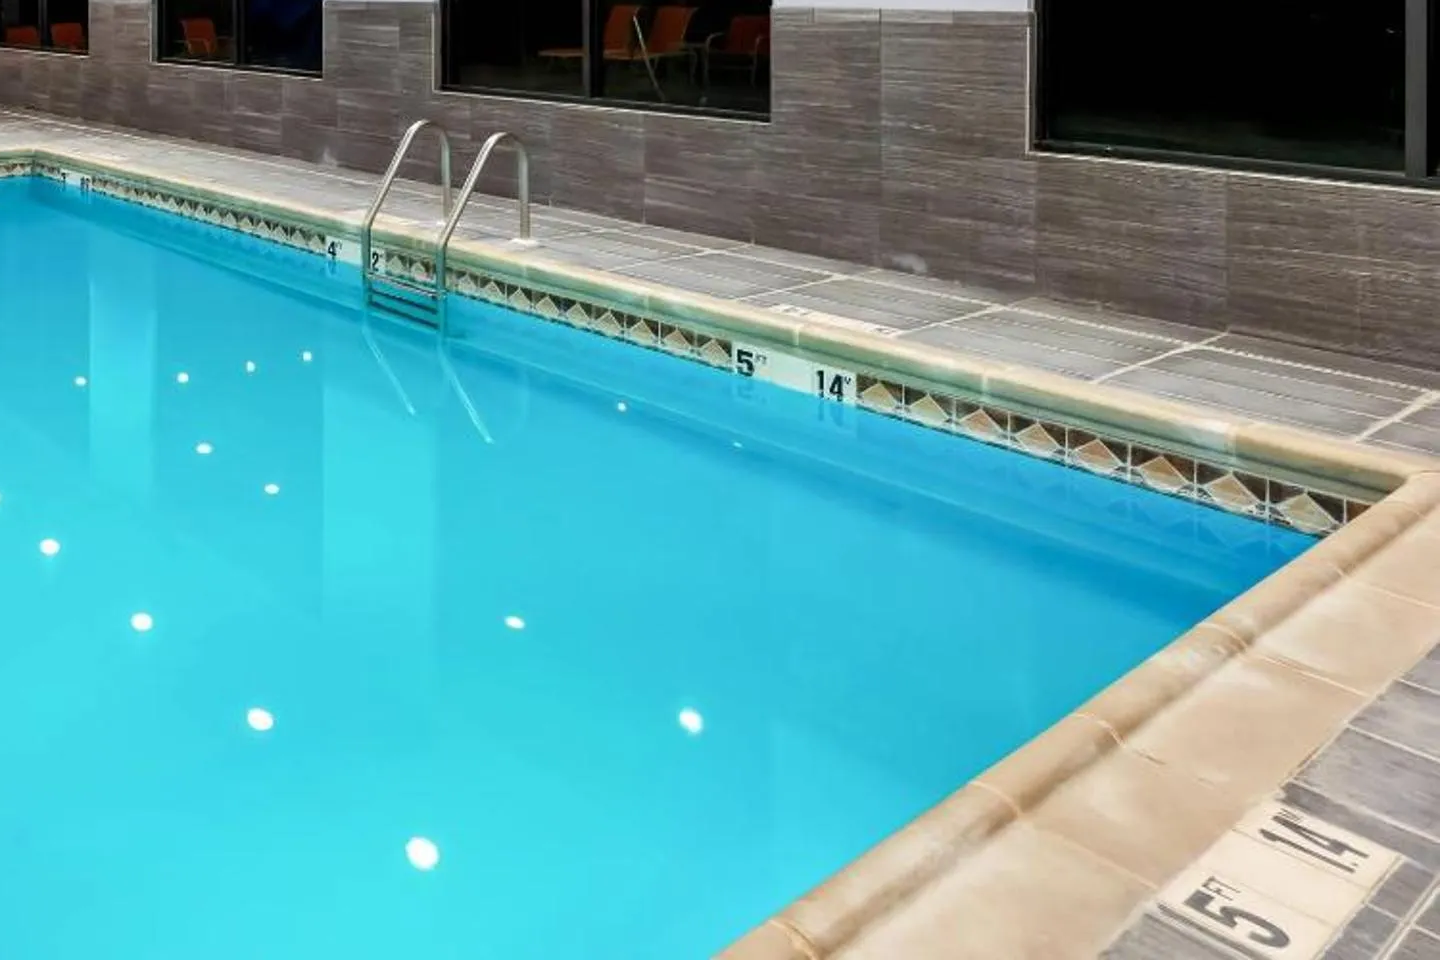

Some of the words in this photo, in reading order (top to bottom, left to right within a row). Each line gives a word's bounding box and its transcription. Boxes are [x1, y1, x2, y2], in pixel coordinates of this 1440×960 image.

[327, 241, 337, 259] 4
[736, 348, 755, 377] 5
[1183, 890, 1291, 949] 5
